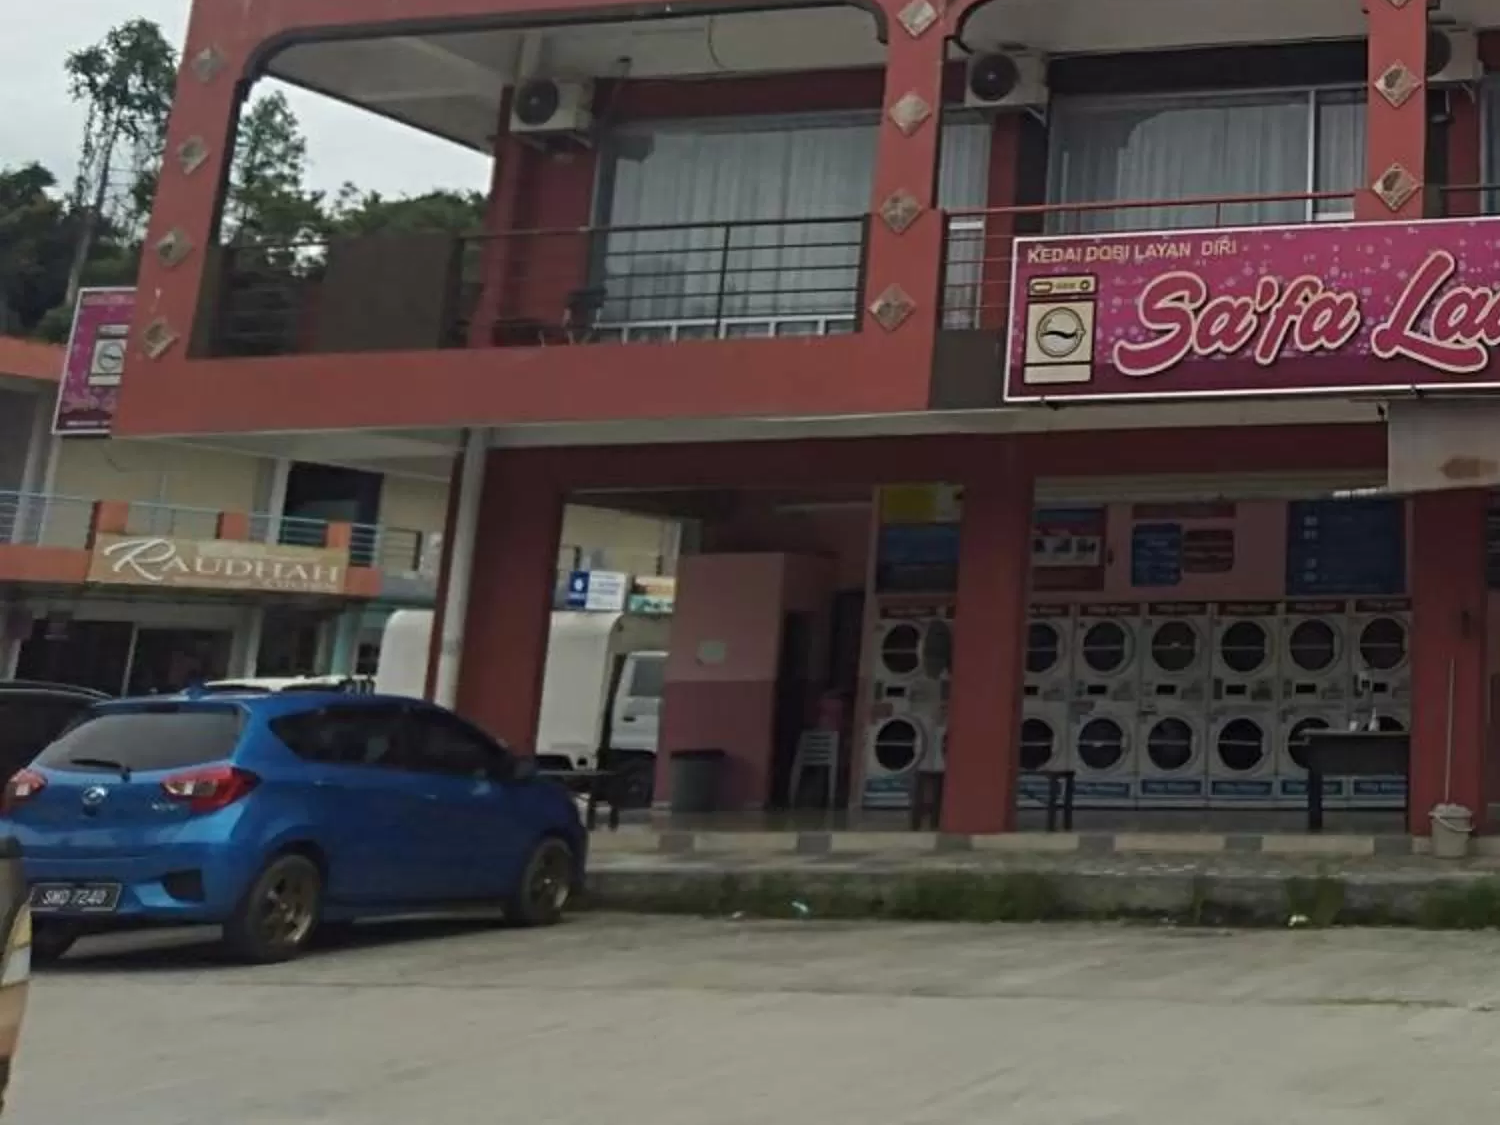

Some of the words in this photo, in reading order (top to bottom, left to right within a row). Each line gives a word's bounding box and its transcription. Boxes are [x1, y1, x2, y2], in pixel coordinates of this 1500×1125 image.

[1027, 246, 1081, 264] KEDAI
[1085, 244, 1129, 262] DOBI
[1134, 241, 1191, 260] LAYAN
[1201, 239, 1237, 256] DIRI
[103, 537, 338, 583] RAUDHAH
